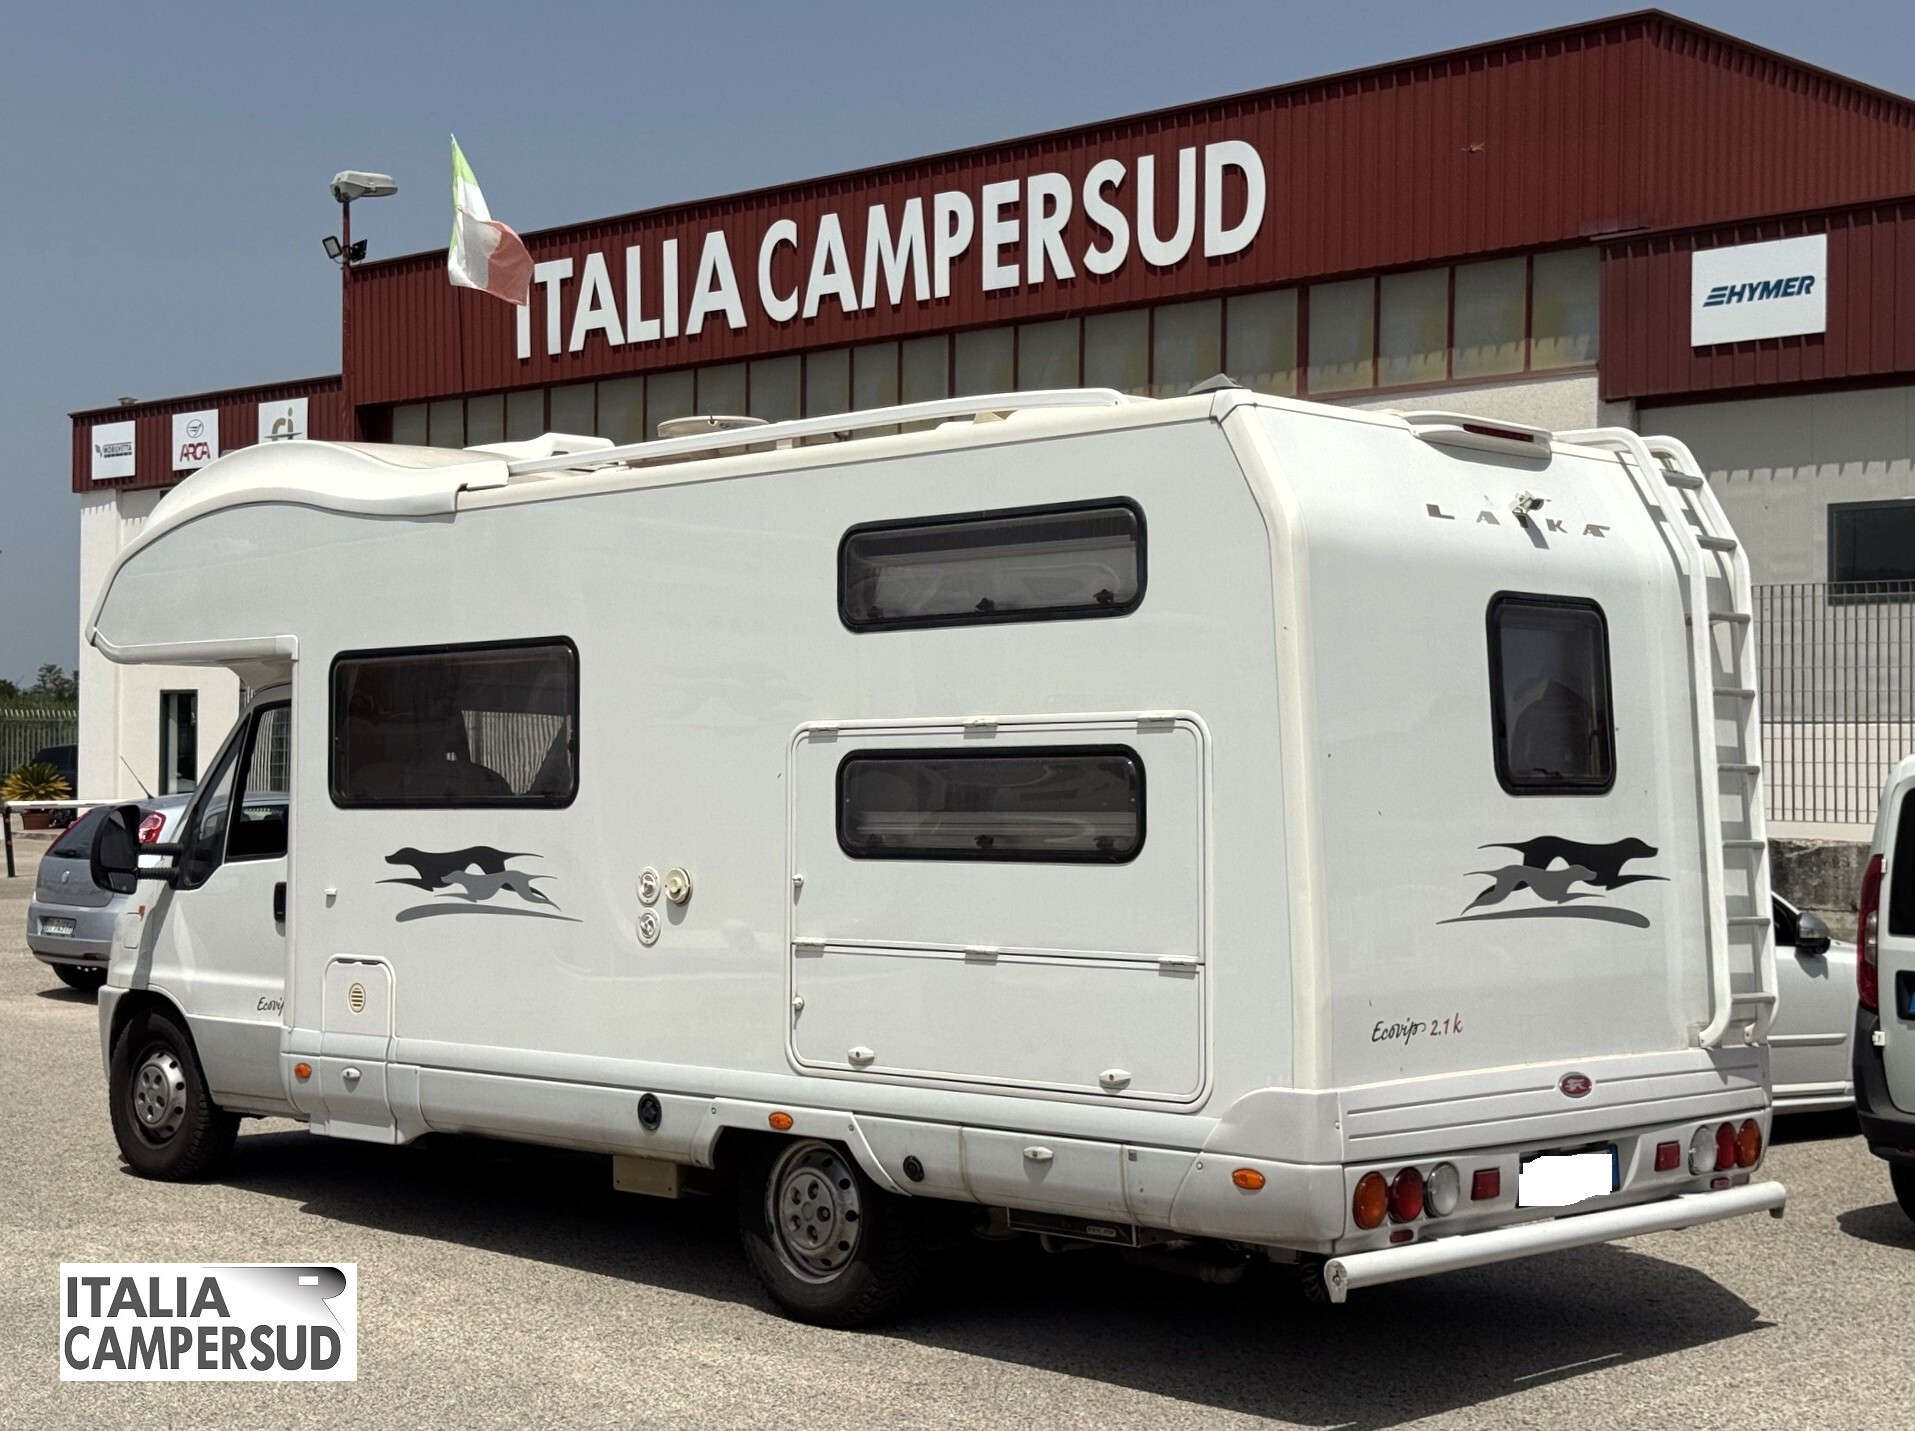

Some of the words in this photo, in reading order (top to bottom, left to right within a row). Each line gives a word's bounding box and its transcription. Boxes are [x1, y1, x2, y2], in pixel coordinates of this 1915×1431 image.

[516, 230, 747, 359] ITALIA
[758, 140, 1266, 323] CAMPERSUD
[1725, 275, 1815, 305] HYMER
[179, 441, 211, 462] ARCA
[1371, 1017, 1426, 1046] Ecovip
